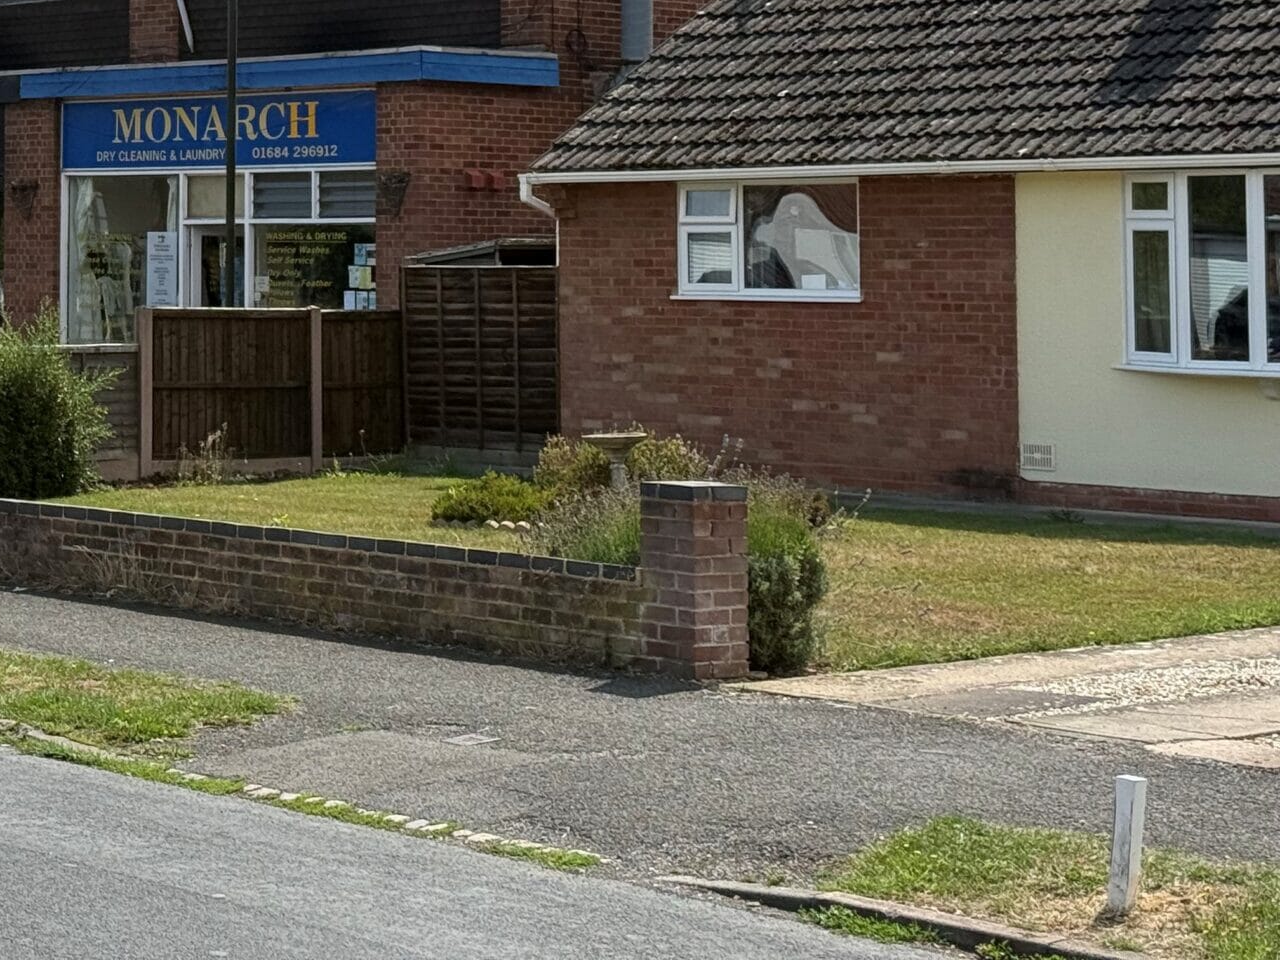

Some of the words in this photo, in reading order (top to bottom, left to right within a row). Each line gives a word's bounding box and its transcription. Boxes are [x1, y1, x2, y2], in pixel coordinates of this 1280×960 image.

[112, 101, 319, 143] MONARCH
[97, 151, 116, 162] DRY
[118, 150, 167, 161] CLEANING
[170, 150, 177, 160] &
[180, 148, 226, 161] LAUNDRY
[252, 146, 289, 158] 01684
[293, 145, 338, 157] 296912
[266, 232, 304, 240] WASHING
[306, 232, 312, 240] &
[315, 231, 347, 240] DRYING
[267, 245, 296, 254] Service
[299, 245, 330, 254] Washes
